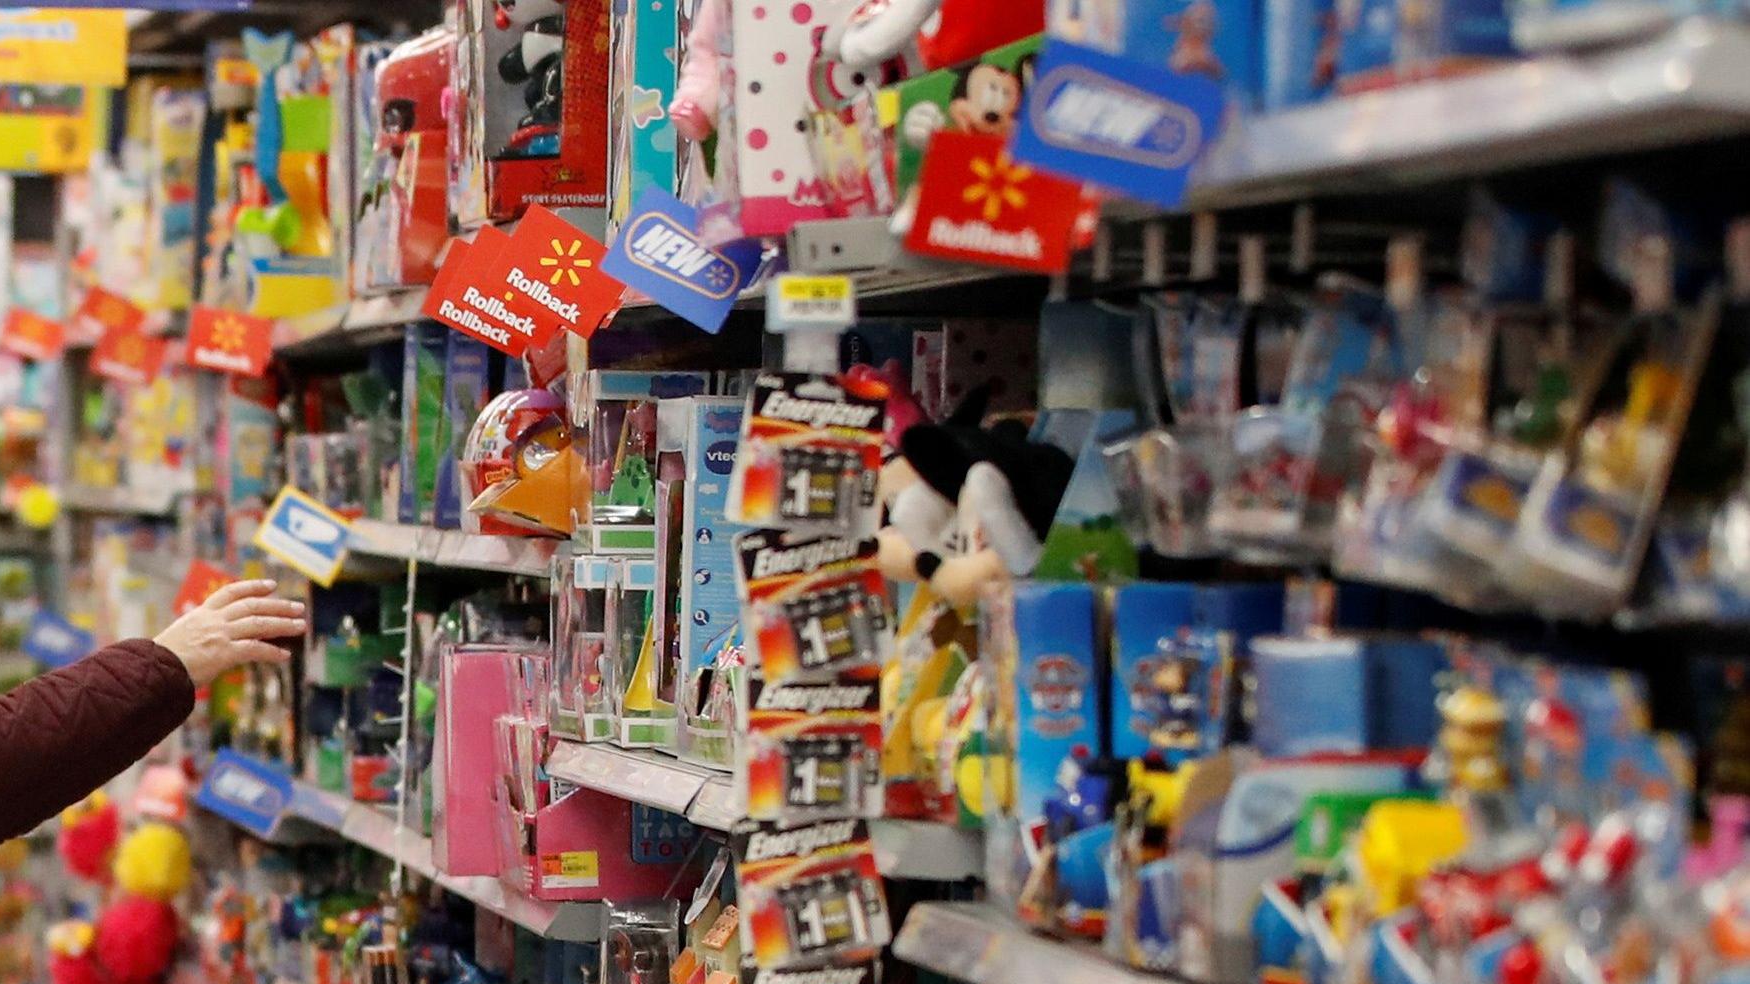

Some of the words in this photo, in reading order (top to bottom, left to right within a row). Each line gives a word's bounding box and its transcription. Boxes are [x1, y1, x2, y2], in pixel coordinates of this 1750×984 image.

[632, 223, 717, 278] NEW
[928, 215, 1043, 260] Rollback
[462, 286, 538, 338] Rollback
[505, 267, 582, 325] Rollback
[439, 300, 512, 346] Rollback
[760, 391, 878, 429] Energizer
[706, 451, 738, 462] vtec
[752, 539, 861, 579] Energizer
[755, 680, 874, 714] Energizer
[640, 822, 693, 838] TAC
[745, 820, 859, 862] Energizer
